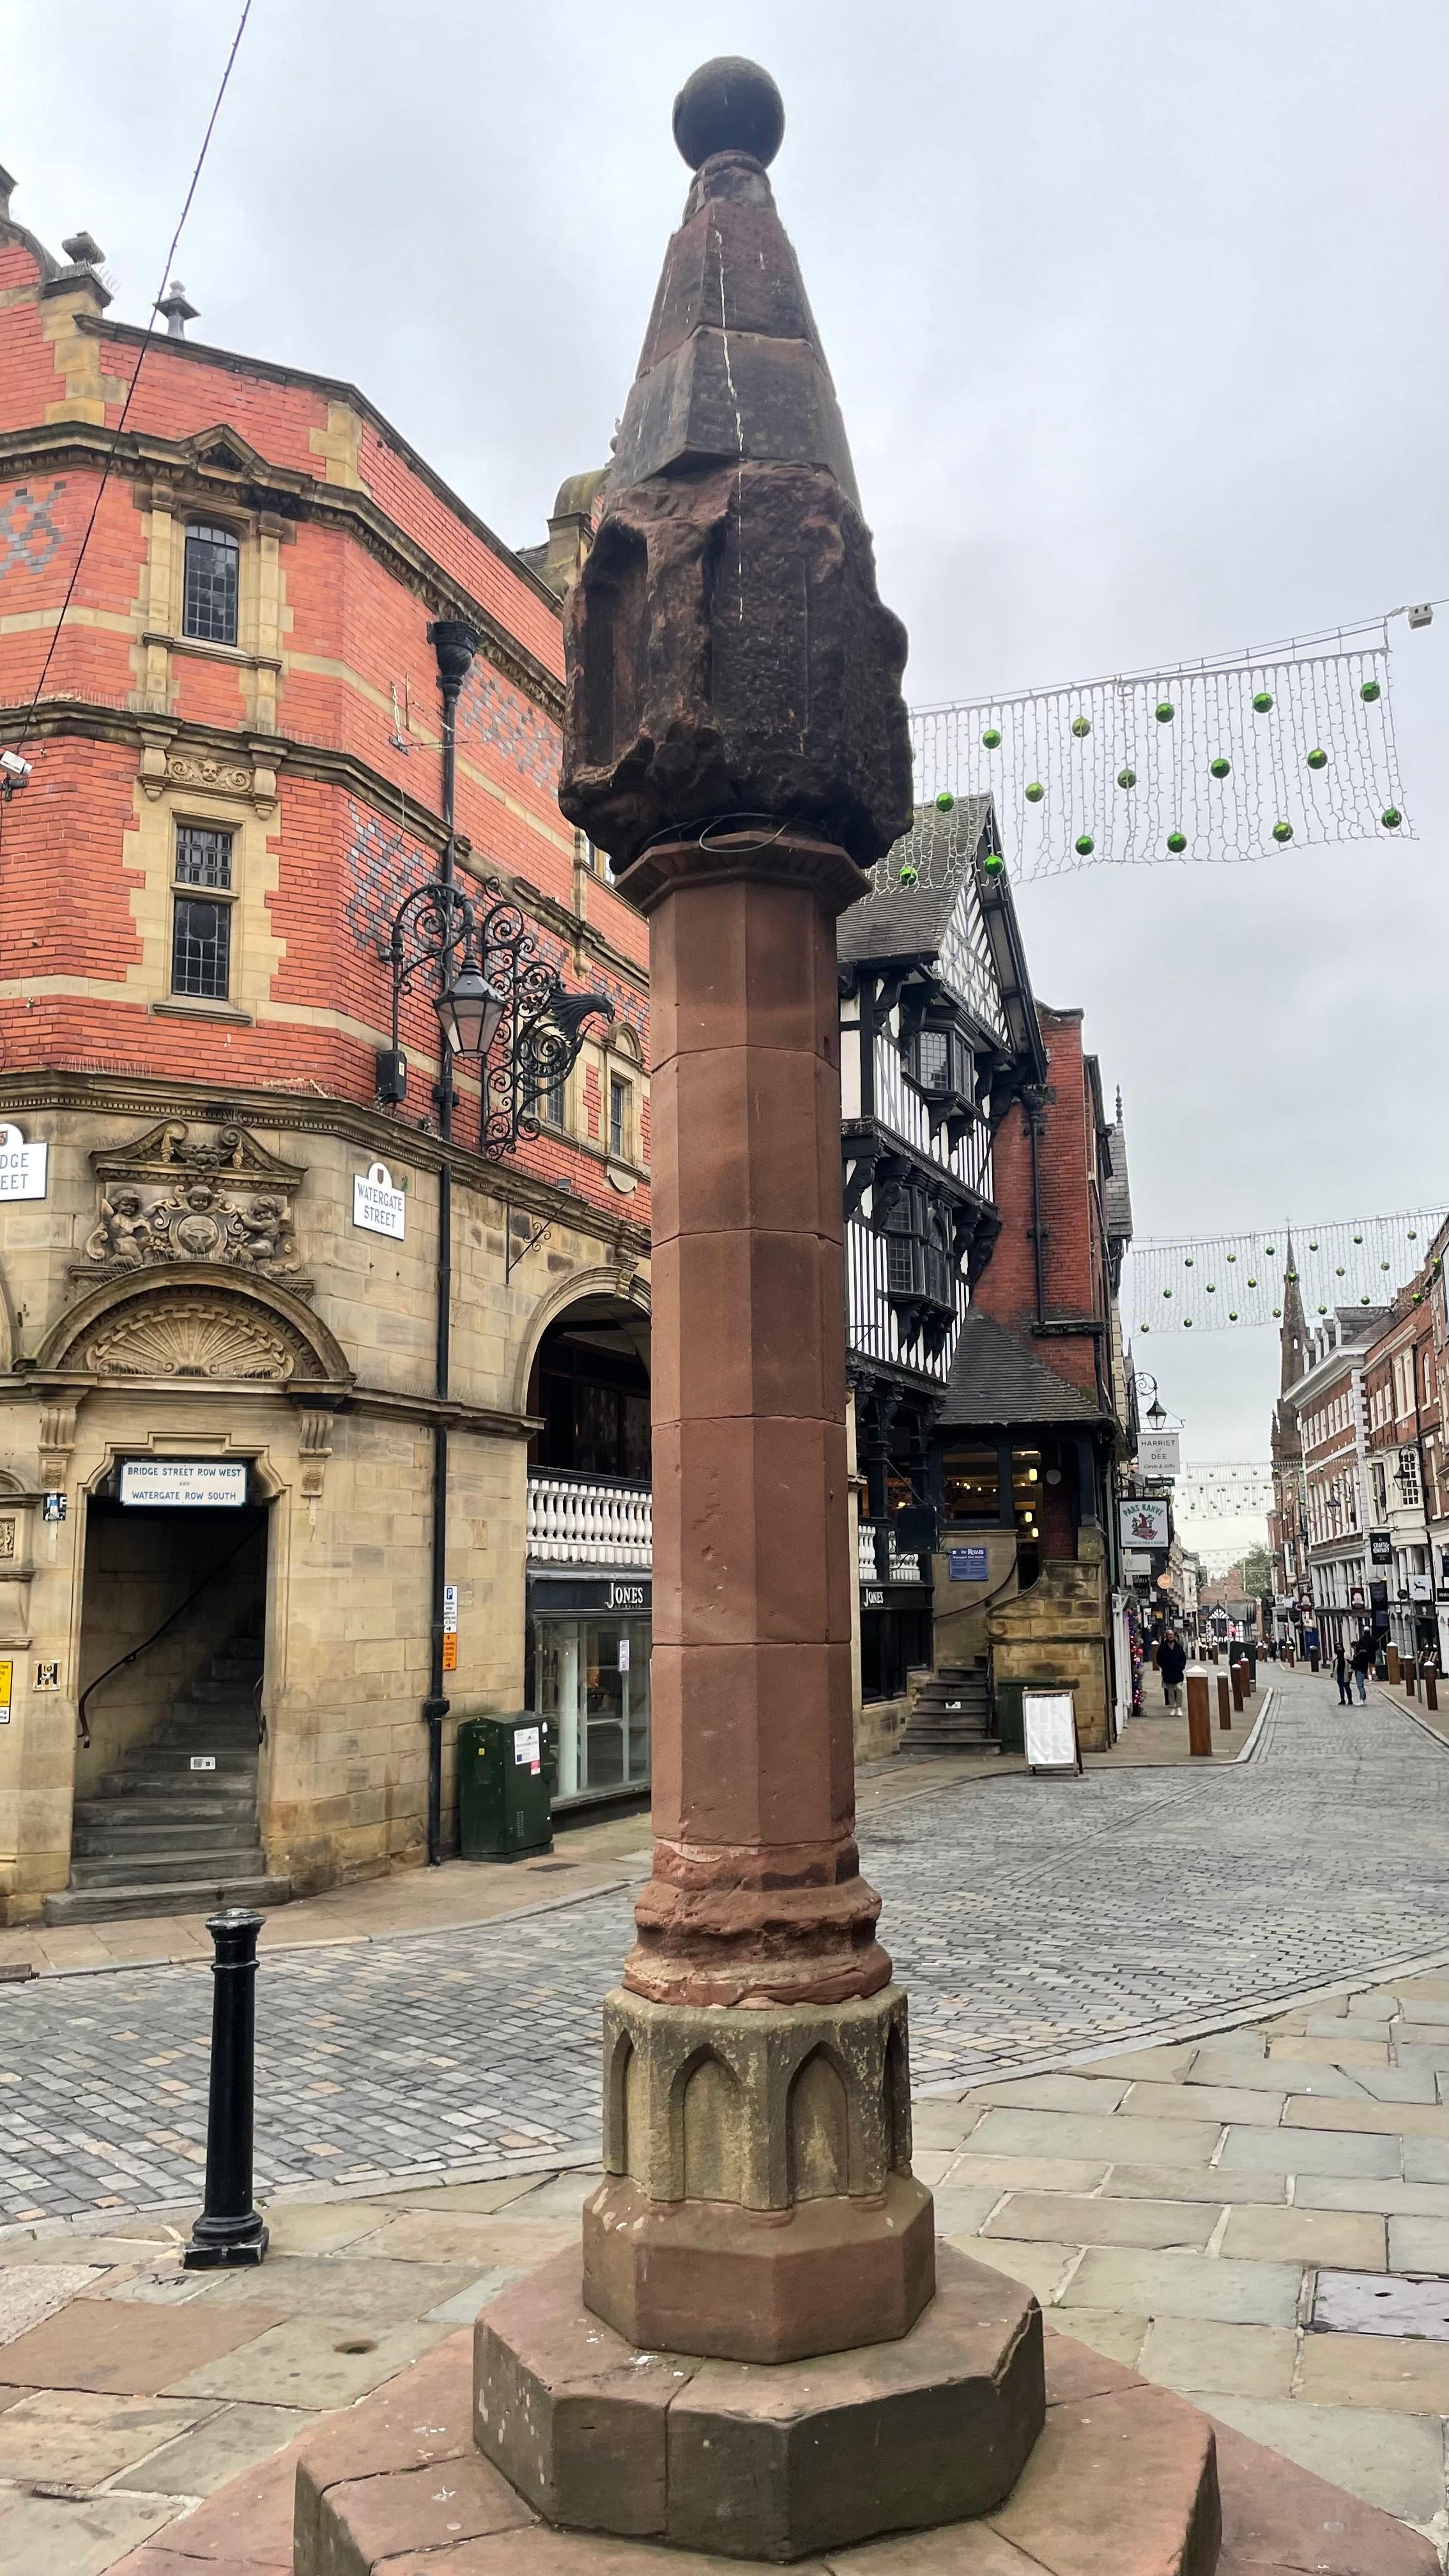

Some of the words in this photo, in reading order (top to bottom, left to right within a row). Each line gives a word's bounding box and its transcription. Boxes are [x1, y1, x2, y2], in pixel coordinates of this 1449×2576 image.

[358, 1183, 402, 1211] WATERGATE
[364, 1205, 395, 1228] STREET
[128, 1467, 158, 1475] BRIDGE
[162, 1468, 194, 1476] STREET
[197, 1468, 216, 1476] ROW
[218, 1469, 241, 1477] WEST
[132, 1491, 180, 1499] WATERGATE
[208, 1492, 236, 1500] SOUTH
[1123, 1505, 1140, 1517] PARS
[1142, 1503, 1164, 1518] KAHVE
[447, 1588, 452, 1598] P
[604, 1583, 643, 1609] JONES
[864, 1588, 884, 1607] JONES
